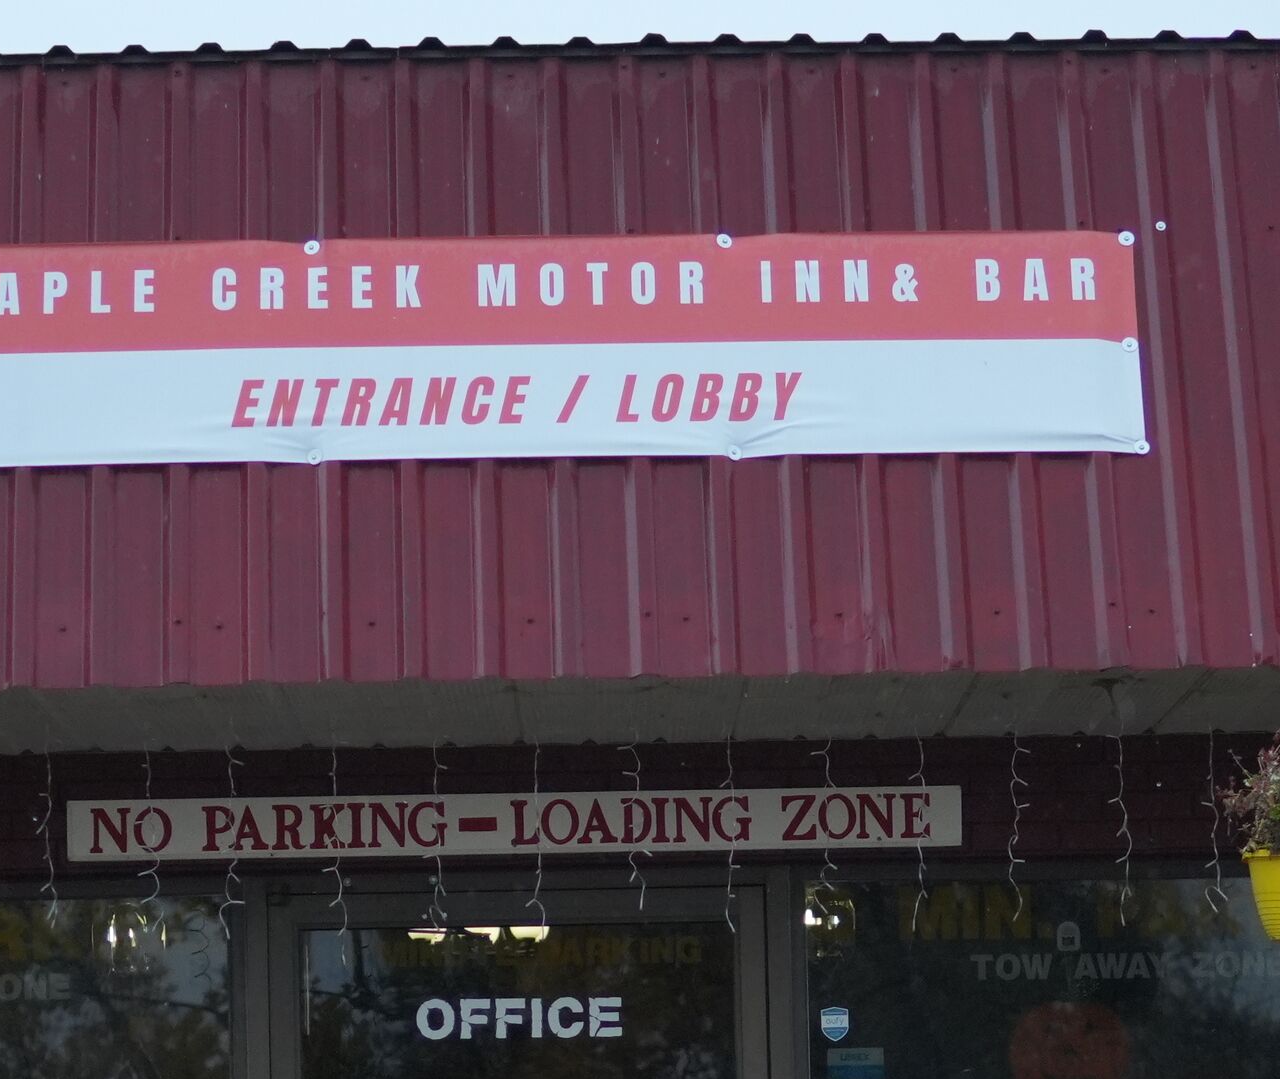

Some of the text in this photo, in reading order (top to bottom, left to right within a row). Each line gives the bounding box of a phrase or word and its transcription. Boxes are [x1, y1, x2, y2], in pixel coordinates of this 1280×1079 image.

[212, 265, 422, 312] CREEK
[477, 260, 704, 307] MOTOR
[974, 257, 1097, 302] BAR
[231, 375, 532, 428] ENTRANCE
[616, 371, 803, 422] LOBBY
[89, 806, 173, 854] NO
[780, 793, 931, 842] ZONE
[970, 953, 1053, 981] TOW
[1073, 951, 1172, 980] AWAY
[415, 996, 624, 1040] OFFICE
